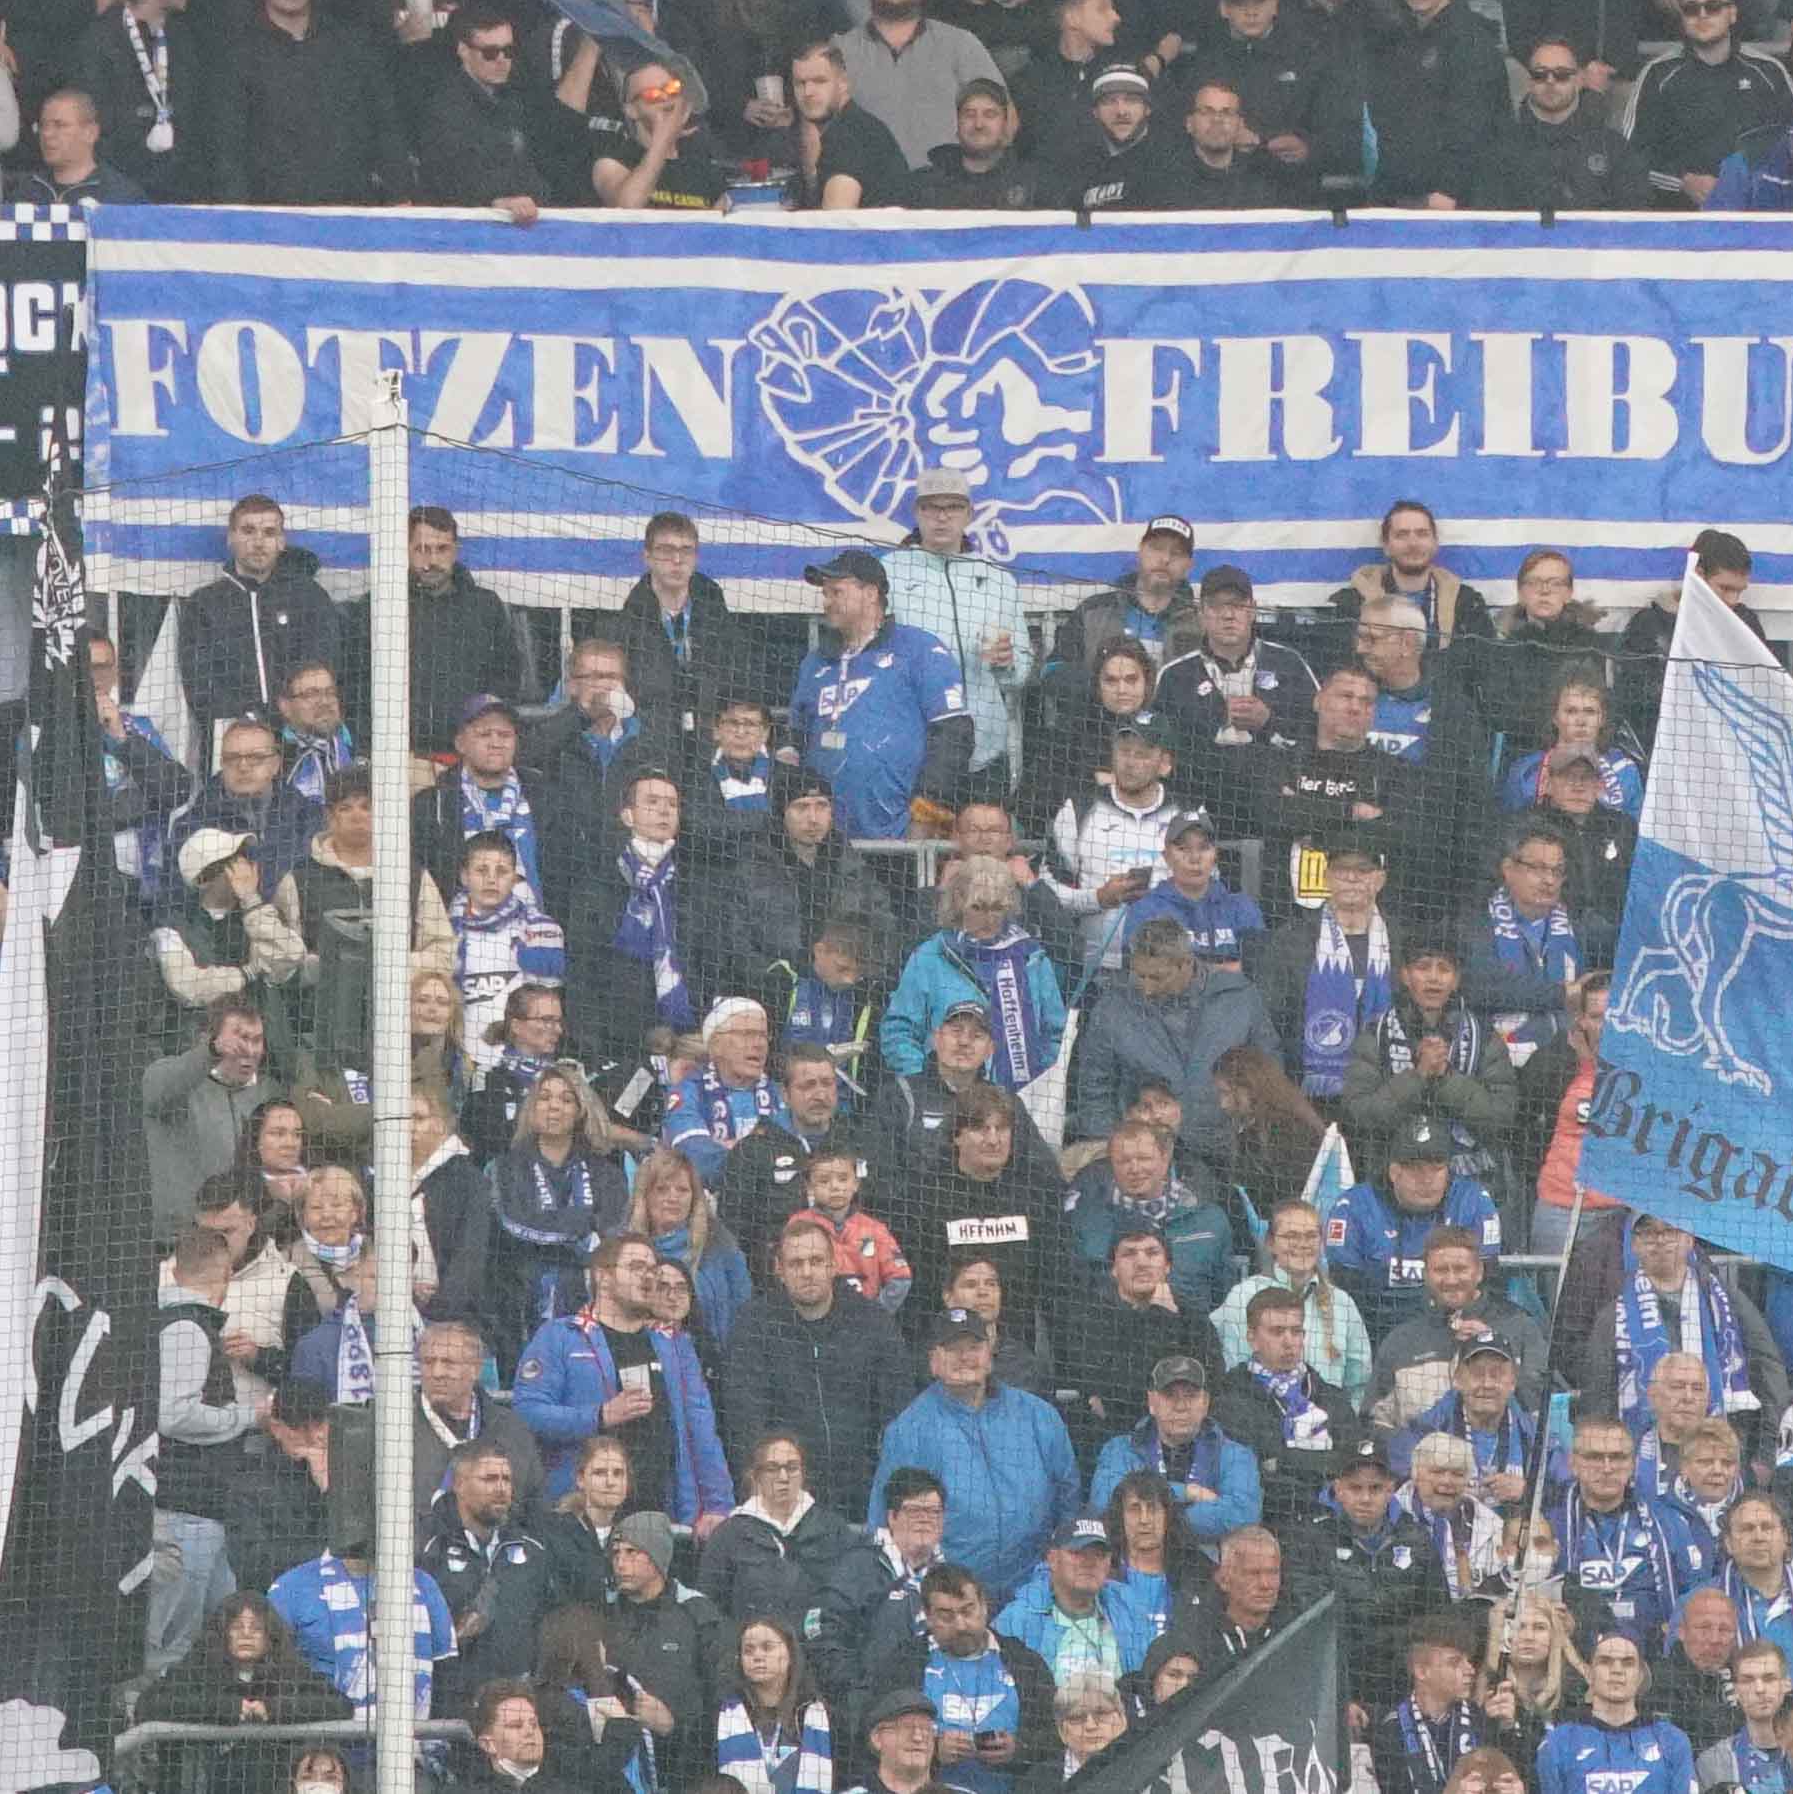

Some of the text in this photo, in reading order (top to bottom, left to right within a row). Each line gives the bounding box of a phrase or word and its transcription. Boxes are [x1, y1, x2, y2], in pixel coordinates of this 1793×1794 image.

[101, 318, 748, 459] FOTZEN
[997, 976, 1027, 1072] Hoffenheim
[957, 1221, 1018, 1239] HFFNHM
[1582, 1564, 1627, 1586] SAP
